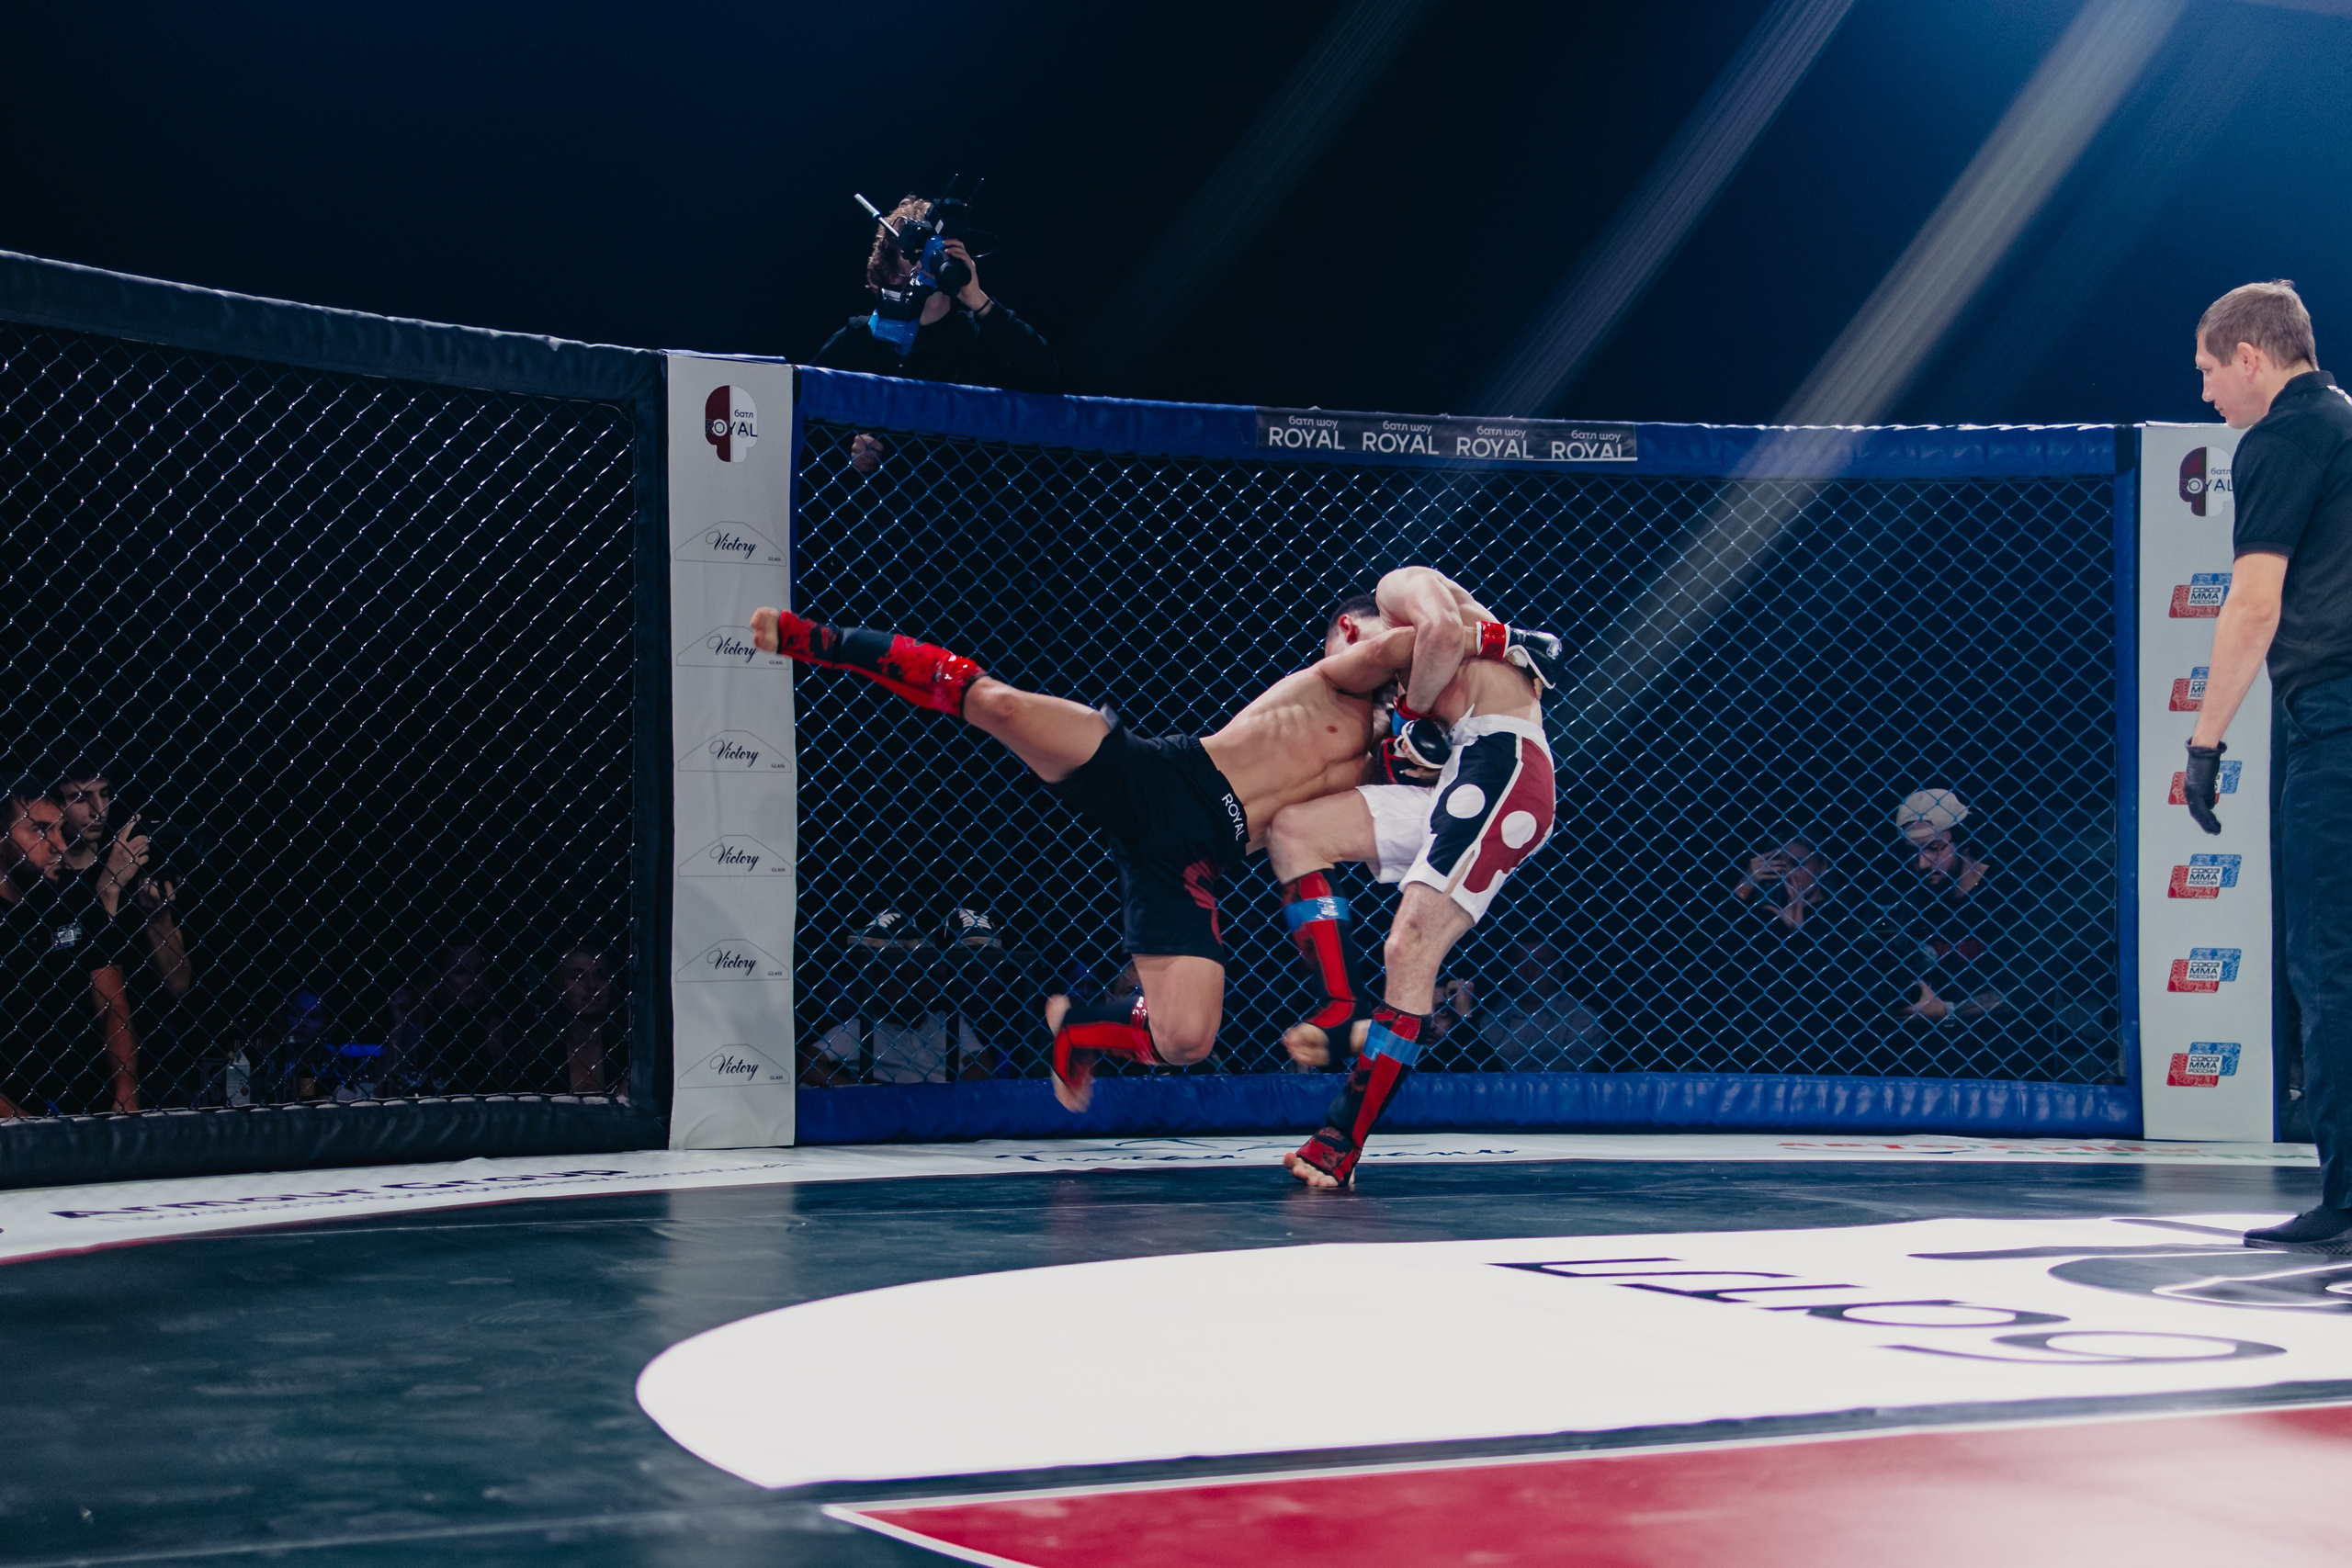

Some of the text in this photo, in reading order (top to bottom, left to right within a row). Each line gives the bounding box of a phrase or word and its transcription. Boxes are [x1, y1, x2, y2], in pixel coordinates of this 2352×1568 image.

[734, 409, 754, 419] батл
[1288, 415, 1339, 430] батл шоу
[1382, 421, 1432, 434] батл шоу
[705, 419, 758, 438] ROYAL
[1476, 425, 1526, 439] батл шоу
[1571, 430, 1621, 444] батл шоу
[1269, 426, 1624, 460] ROYAL ROYAL ROYAL ROYAL
[2180, 479, 2233, 492] ROYAL
[706, 528, 757, 559] Victory
[707, 634, 758, 663] Victory
[708, 739, 761, 769] Victory
[1222, 793, 1245, 840] ROYAL
[709, 842, 761, 872] Victory
[707, 948, 757, 977] Victory
[709, 1053, 760, 1080] Victory
[49, 1189, 378, 1219] Armour
[380, 1169, 630, 1190] Group
